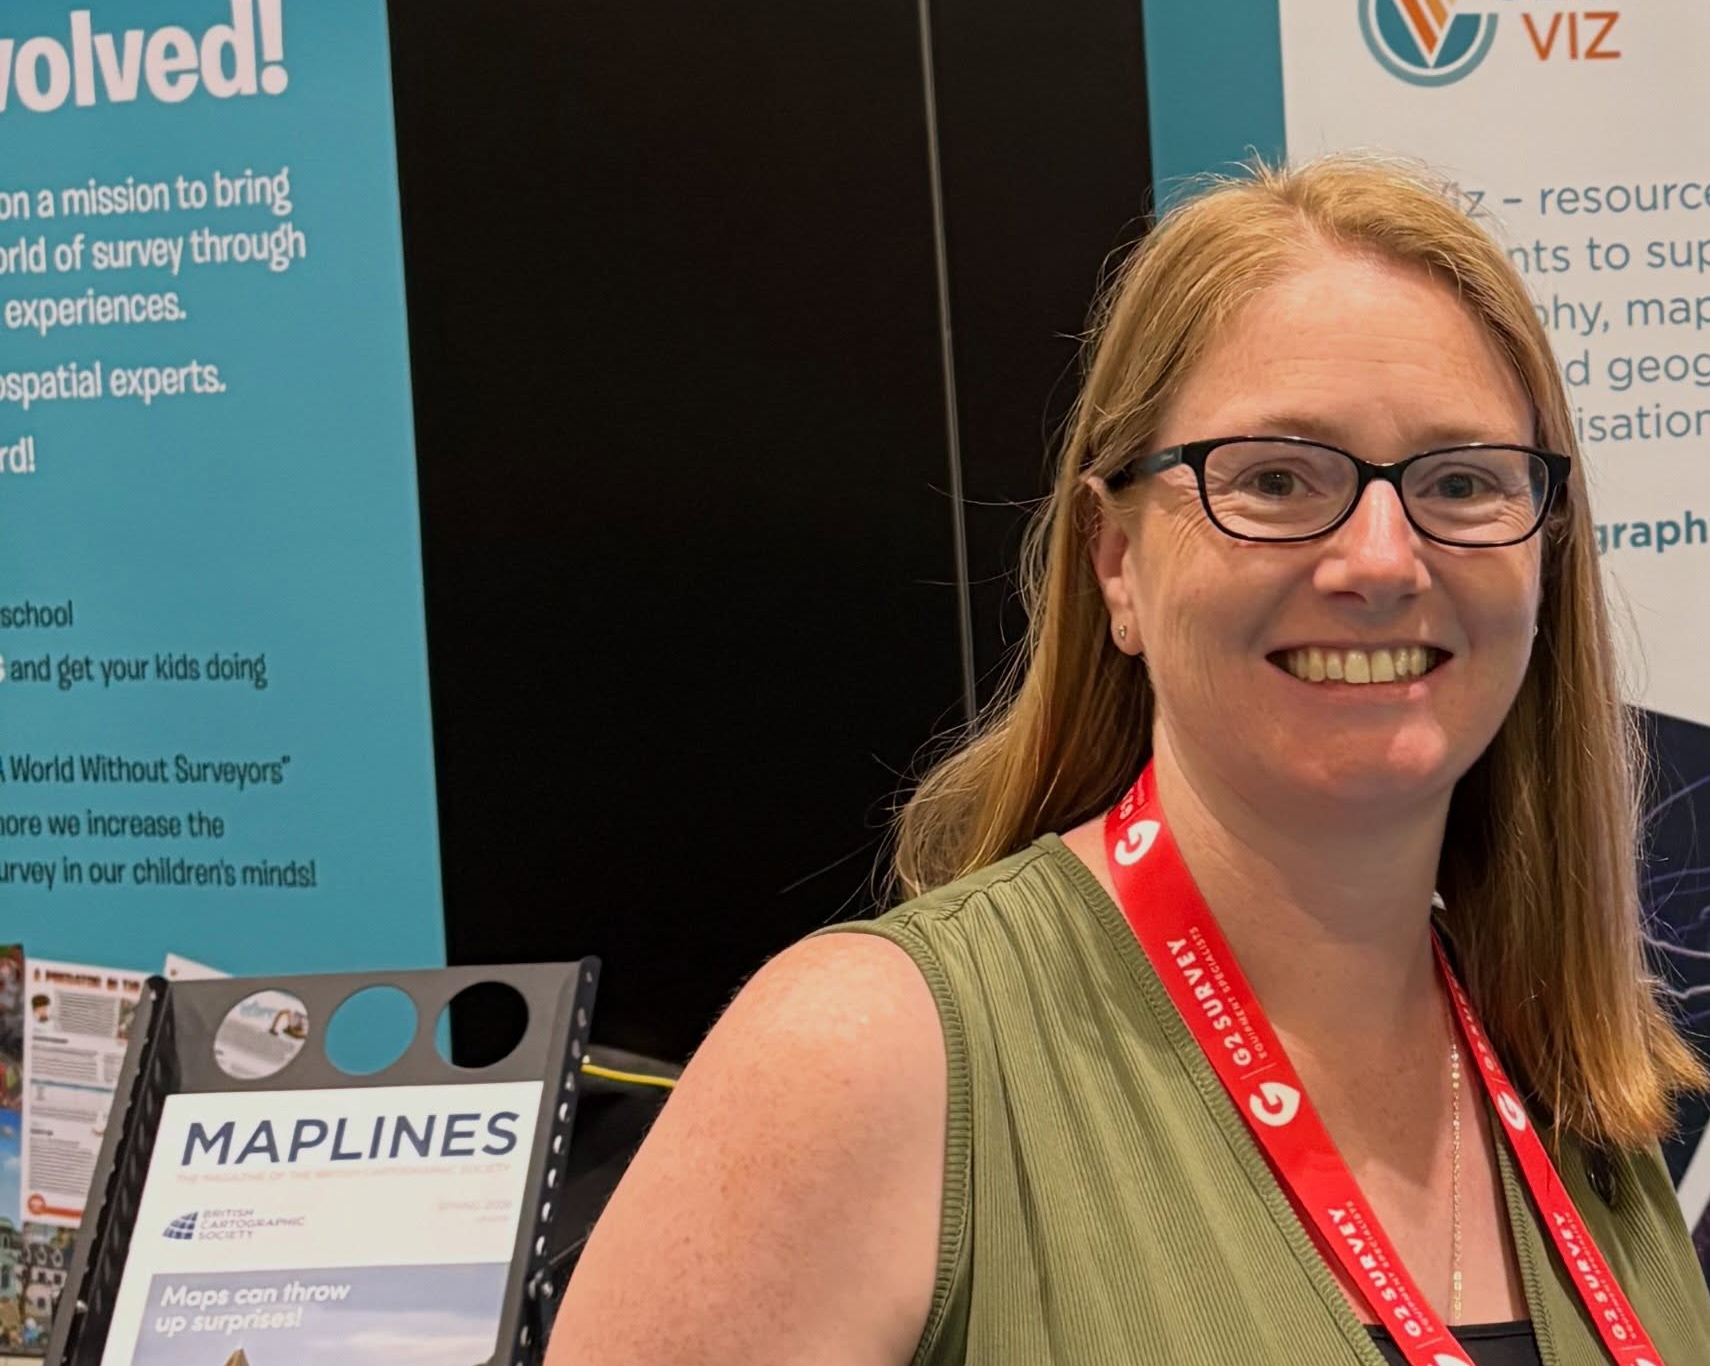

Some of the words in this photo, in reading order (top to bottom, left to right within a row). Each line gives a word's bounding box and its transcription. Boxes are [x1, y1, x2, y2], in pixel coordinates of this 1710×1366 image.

[1521, 11, 1622, 62] VIZ
[0, 188, 30, 220] on
[36, 189, 55, 218] a
[61, 177, 170, 217] mission
[175, 175, 208, 210] to
[213, 166, 294, 217] bring
[54, 232, 85, 273] of
[91, 236, 184, 276] survey
[189, 221, 307, 273] through
[1586, 236, 1631, 272] to
[4, 287, 187, 337] experiences.
[109, 359, 227, 406] experts.
[0, 599, 74, 629] school
[10, 653, 51, 683] and
[57, 655, 95, 691] get
[99, 656, 150, 688] your
[154, 653, 201, 682] kids
[205, 652, 268, 691] doing
[9, 754, 75, 784] World
[80, 753, 170, 784] Without
[47, 814, 81, 837] we
[87, 808, 182, 838] increase
[187, 811, 225, 838] the
[62, 856, 83, 884] in
[88, 860, 127, 884] our
[132, 857, 237, 888] children's
[241, 859, 318, 889] minds!
[1166, 937, 1233, 1032] SURVEY
[1223, 1035, 1252, 1067] G2
[181, 1111, 520, 1166] MAPLINES
[199, 1216, 306, 1230] CARTOGRAPHIC
[202, 1208, 255, 1220] BRITISH
[198, 1229, 254, 1242] SOCIETY
[1328, 1207, 1398, 1302] SURVEY
[1552, 1211, 1610, 1304] SURVEY
[160, 1285, 230, 1312] Maps
[234, 1284, 278, 1304] can
[281, 1280, 351, 1303] throw
[154, 1317, 187, 1338] up
[190, 1307, 304, 1336] surprises!
[1394, 1304, 1422, 1337] G2
